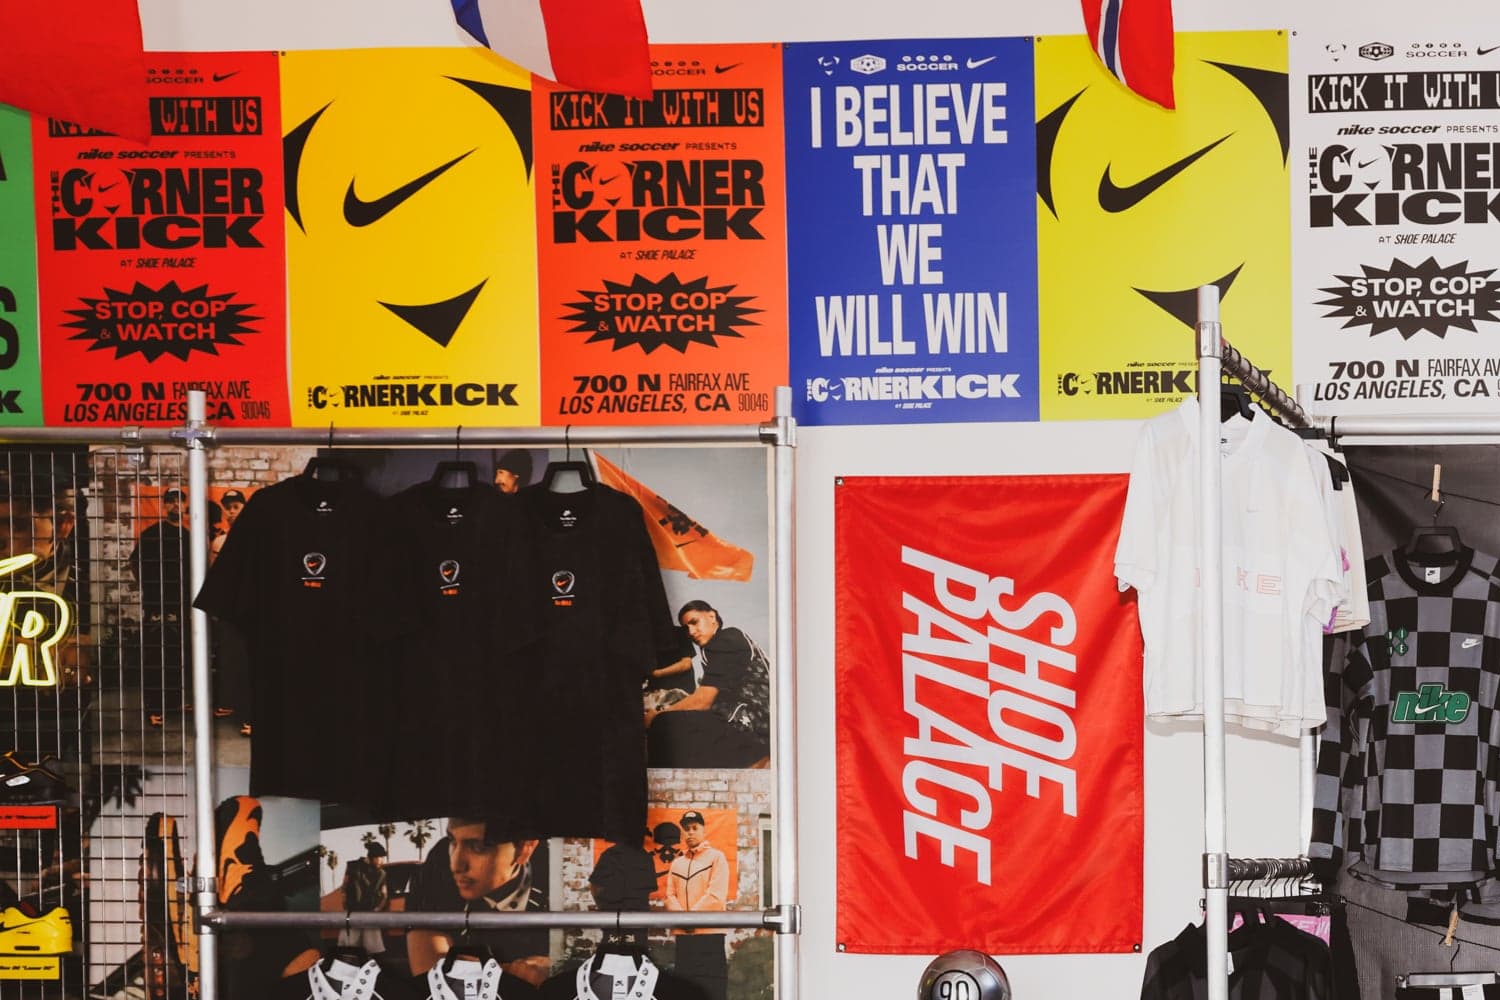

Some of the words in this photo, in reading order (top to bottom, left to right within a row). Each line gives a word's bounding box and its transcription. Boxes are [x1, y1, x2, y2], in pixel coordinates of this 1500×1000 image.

[1406, 50, 1468, 58] SOCCER
[896, 63, 959, 71] SOCCER
[1312, 75, 1368, 111] KICK
[1384, 74, 1408, 109] IT
[1422, 72, 1481, 108] WITH
[160, 99, 217, 133] WITH
[232, 99, 257, 133] US
[554, 94, 608, 128] KICK
[624, 95, 645, 126] IT
[663, 92, 719, 125] WITH
[734, 91, 760, 124] US
[810, 87, 822, 148] I
[836, 82, 1008, 148] BELIEVE
[1337, 124, 1375, 136] nike
[1378, 125, 1441, 135] soccer
[1446, 125, 1498, 133] PRESENTS
[77, 148, 114, 160] nike
[118, 150, 178, 160] soccer
[579, 142, 614, 152] nike
[618, 142, 680, 152] soccer
[686, 142, 736, 150] PRESENTS
[1308, 147, 1318, 194] THE
[552, 164, 560, 209] THE
[853, 153, 966, 216] THAT
[52, 216, 264, 250] KICK
[554, 208, 766, 244] KICK
[1378, 236, 1392, 244] AT
[1394, 234, 1419, 244] SHOE
[1420, 233, 1456, 244] PALACE
[162, 258, 196, 268] PALACE
[635, 250, 659, 260] SHOE
[661, 250, 696, 260] PALACE
[876, 224, 944, 286] WE
[1351, 278, 1422, 298] STOP,
[1430, 277, 1486, 296] COP
[96, 301, 164, 320] STOP,
[170, 300, 226, 319] COP
[594, 293, 663, 313] STOP,
[670, 292, 727, 310] COP
[1355, 306, 1368, 317] &
[1372, 299, 1475, 318] WATCH
[100, 330, 110, 340] &
[116, 322, 215, 341] WATCH
[598, 322, 608, 332] &
[614, 314, 716, 332] WATCH
[815, 294, 916, 357] WILL
[922, 292, 1008, 354] WIN
[1329, 360, 1385, 380] 700
[1396, 360, 1420, 378] N
[1428, 358, 1480, 377] FAIRFAX
[76, 383, 132, 402] 700
[142, 382, 164, 400] N
[227, 381, 250, 399] AVE
[574, 374, 628, 394] 700
[638, 374, 660, 392] N
[670, 373, 722, 392] FAIRFAX
[724, 373, 750, 390] AVE
[1314, 382, 1350, 401] LOS
[1354, 380, 1446, 400] ANGELES,
[1454, 379, 1490, 398] CA
[64, 403, 98, 422] LOS
[205, 401, 235, 420] CA
[241, 401, 270, 420] 90046
[560, 396, 594, 415] LOS
[597, 395, 688, 414] ANGELES,
[694, 393, 731, 412] CA
[738, 393, 768, 412] 90046
[988, 576, 1078, 818] SHOE
[1391, 683, 1470, 723] nike
[901, 544, 993, 886] PALACE
